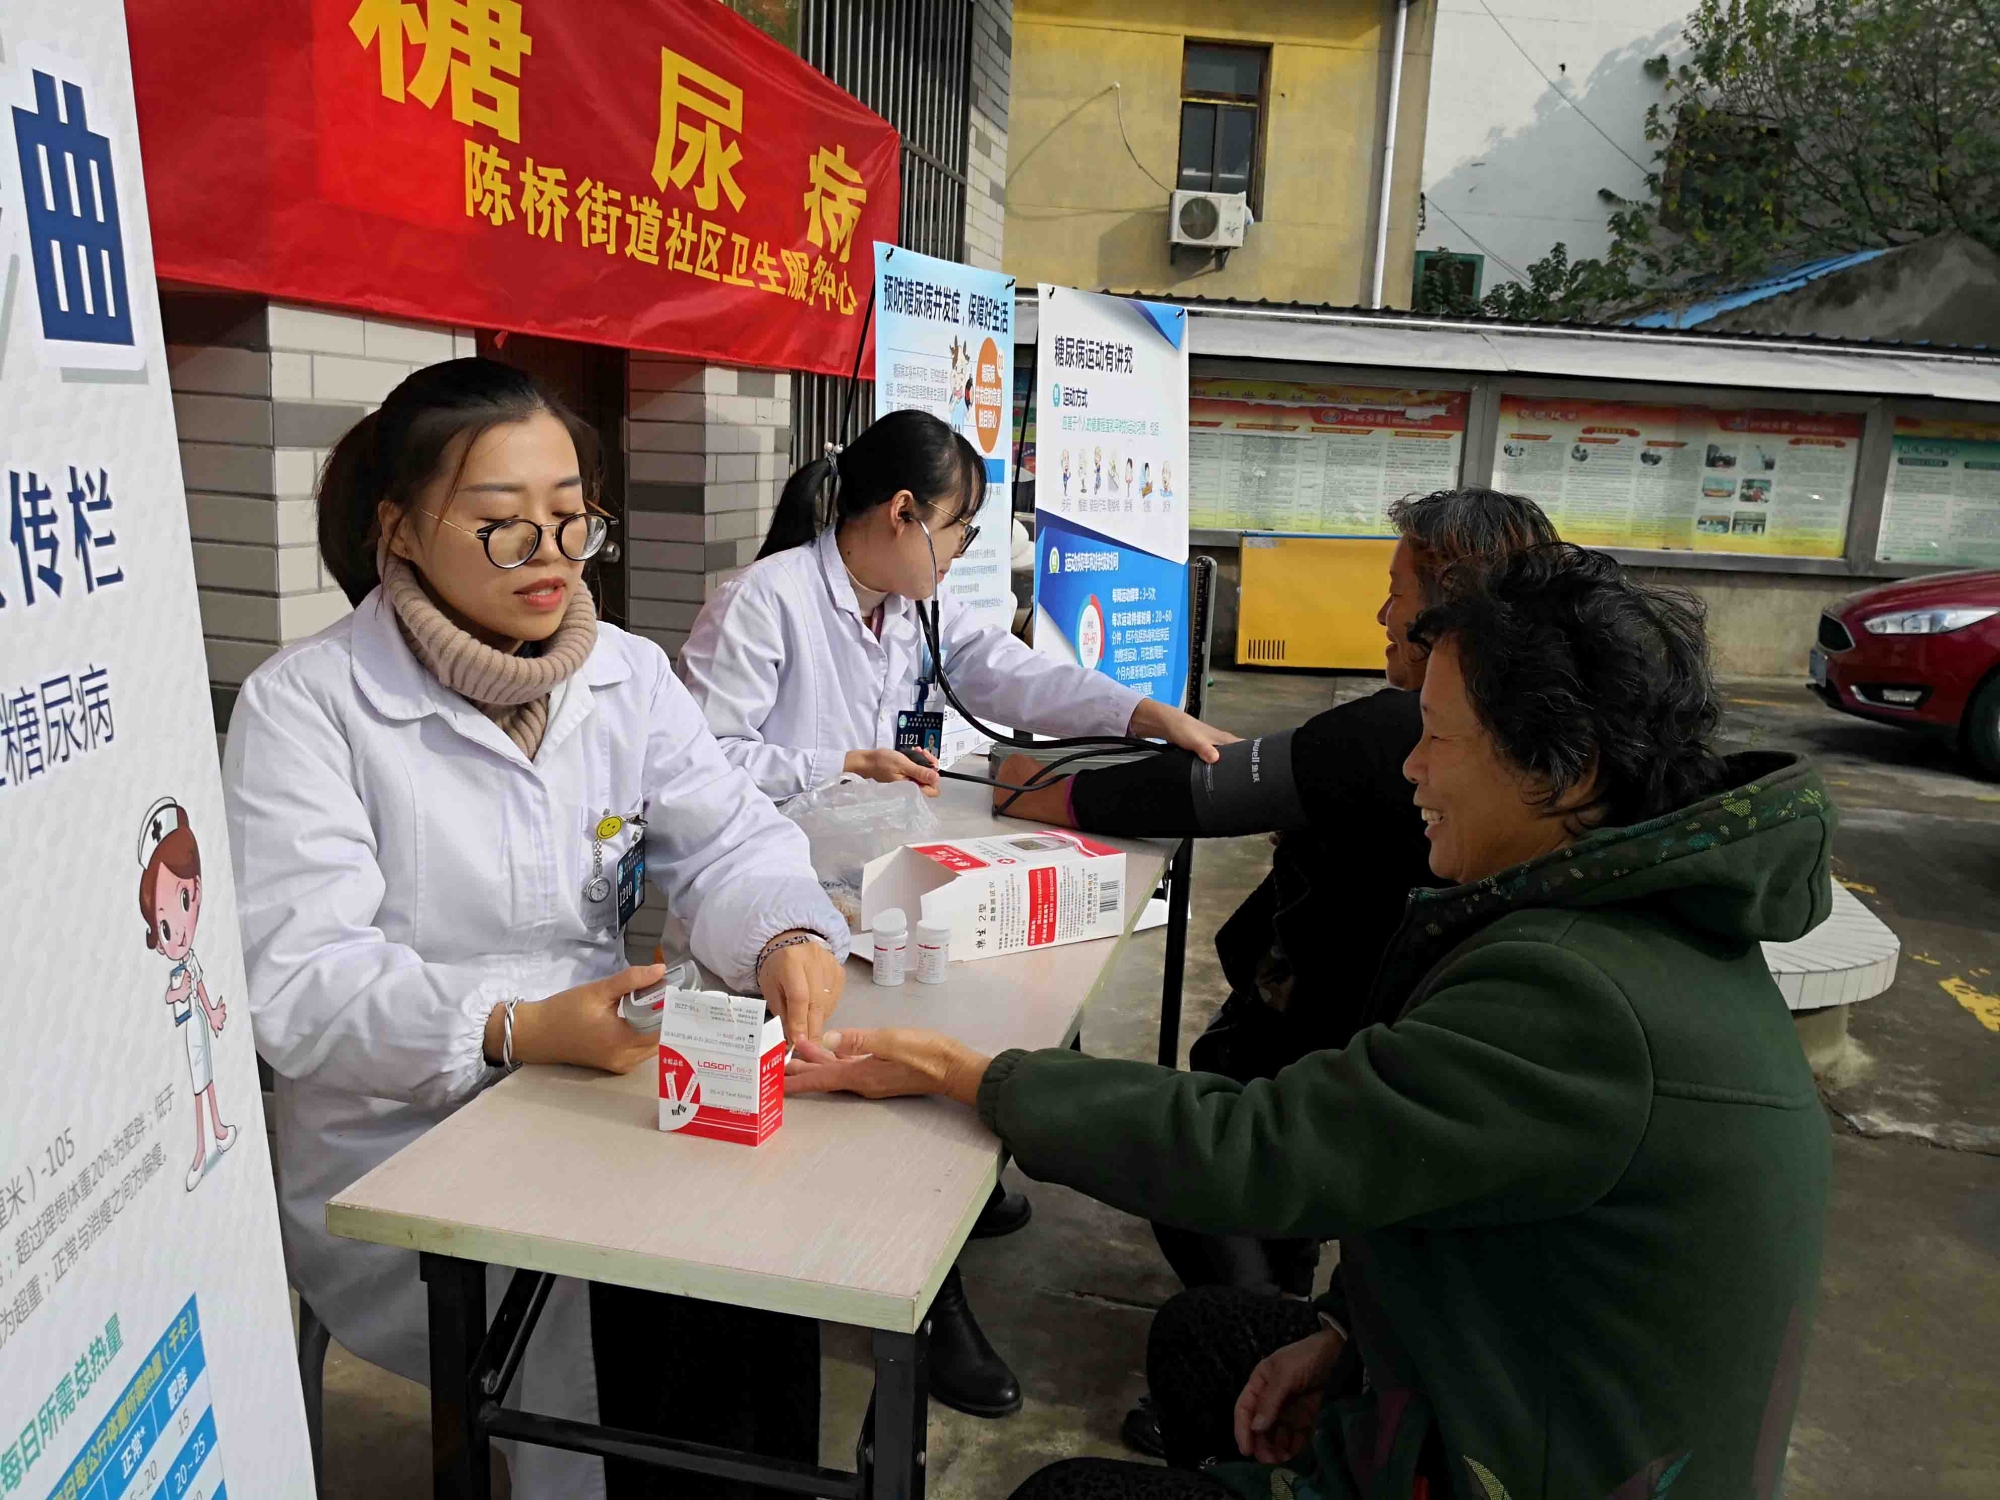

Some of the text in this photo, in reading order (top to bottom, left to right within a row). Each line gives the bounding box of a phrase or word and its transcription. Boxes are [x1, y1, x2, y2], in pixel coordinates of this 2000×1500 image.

[464, 139, 858, 316] 陈桥街道社区卫生服务中心
[884, 274, 1009, 334] 预防糖尿病并发症，保障好生活
[1054, 335, 1134, 374] 糖尿病运动有讲究
[0, 465, 124, 608] 传栏
[0, 663, 114, 787] 糖尿病
[900, 734, 919, 745] 1121
[178, 1408, 189, 1436] 15
